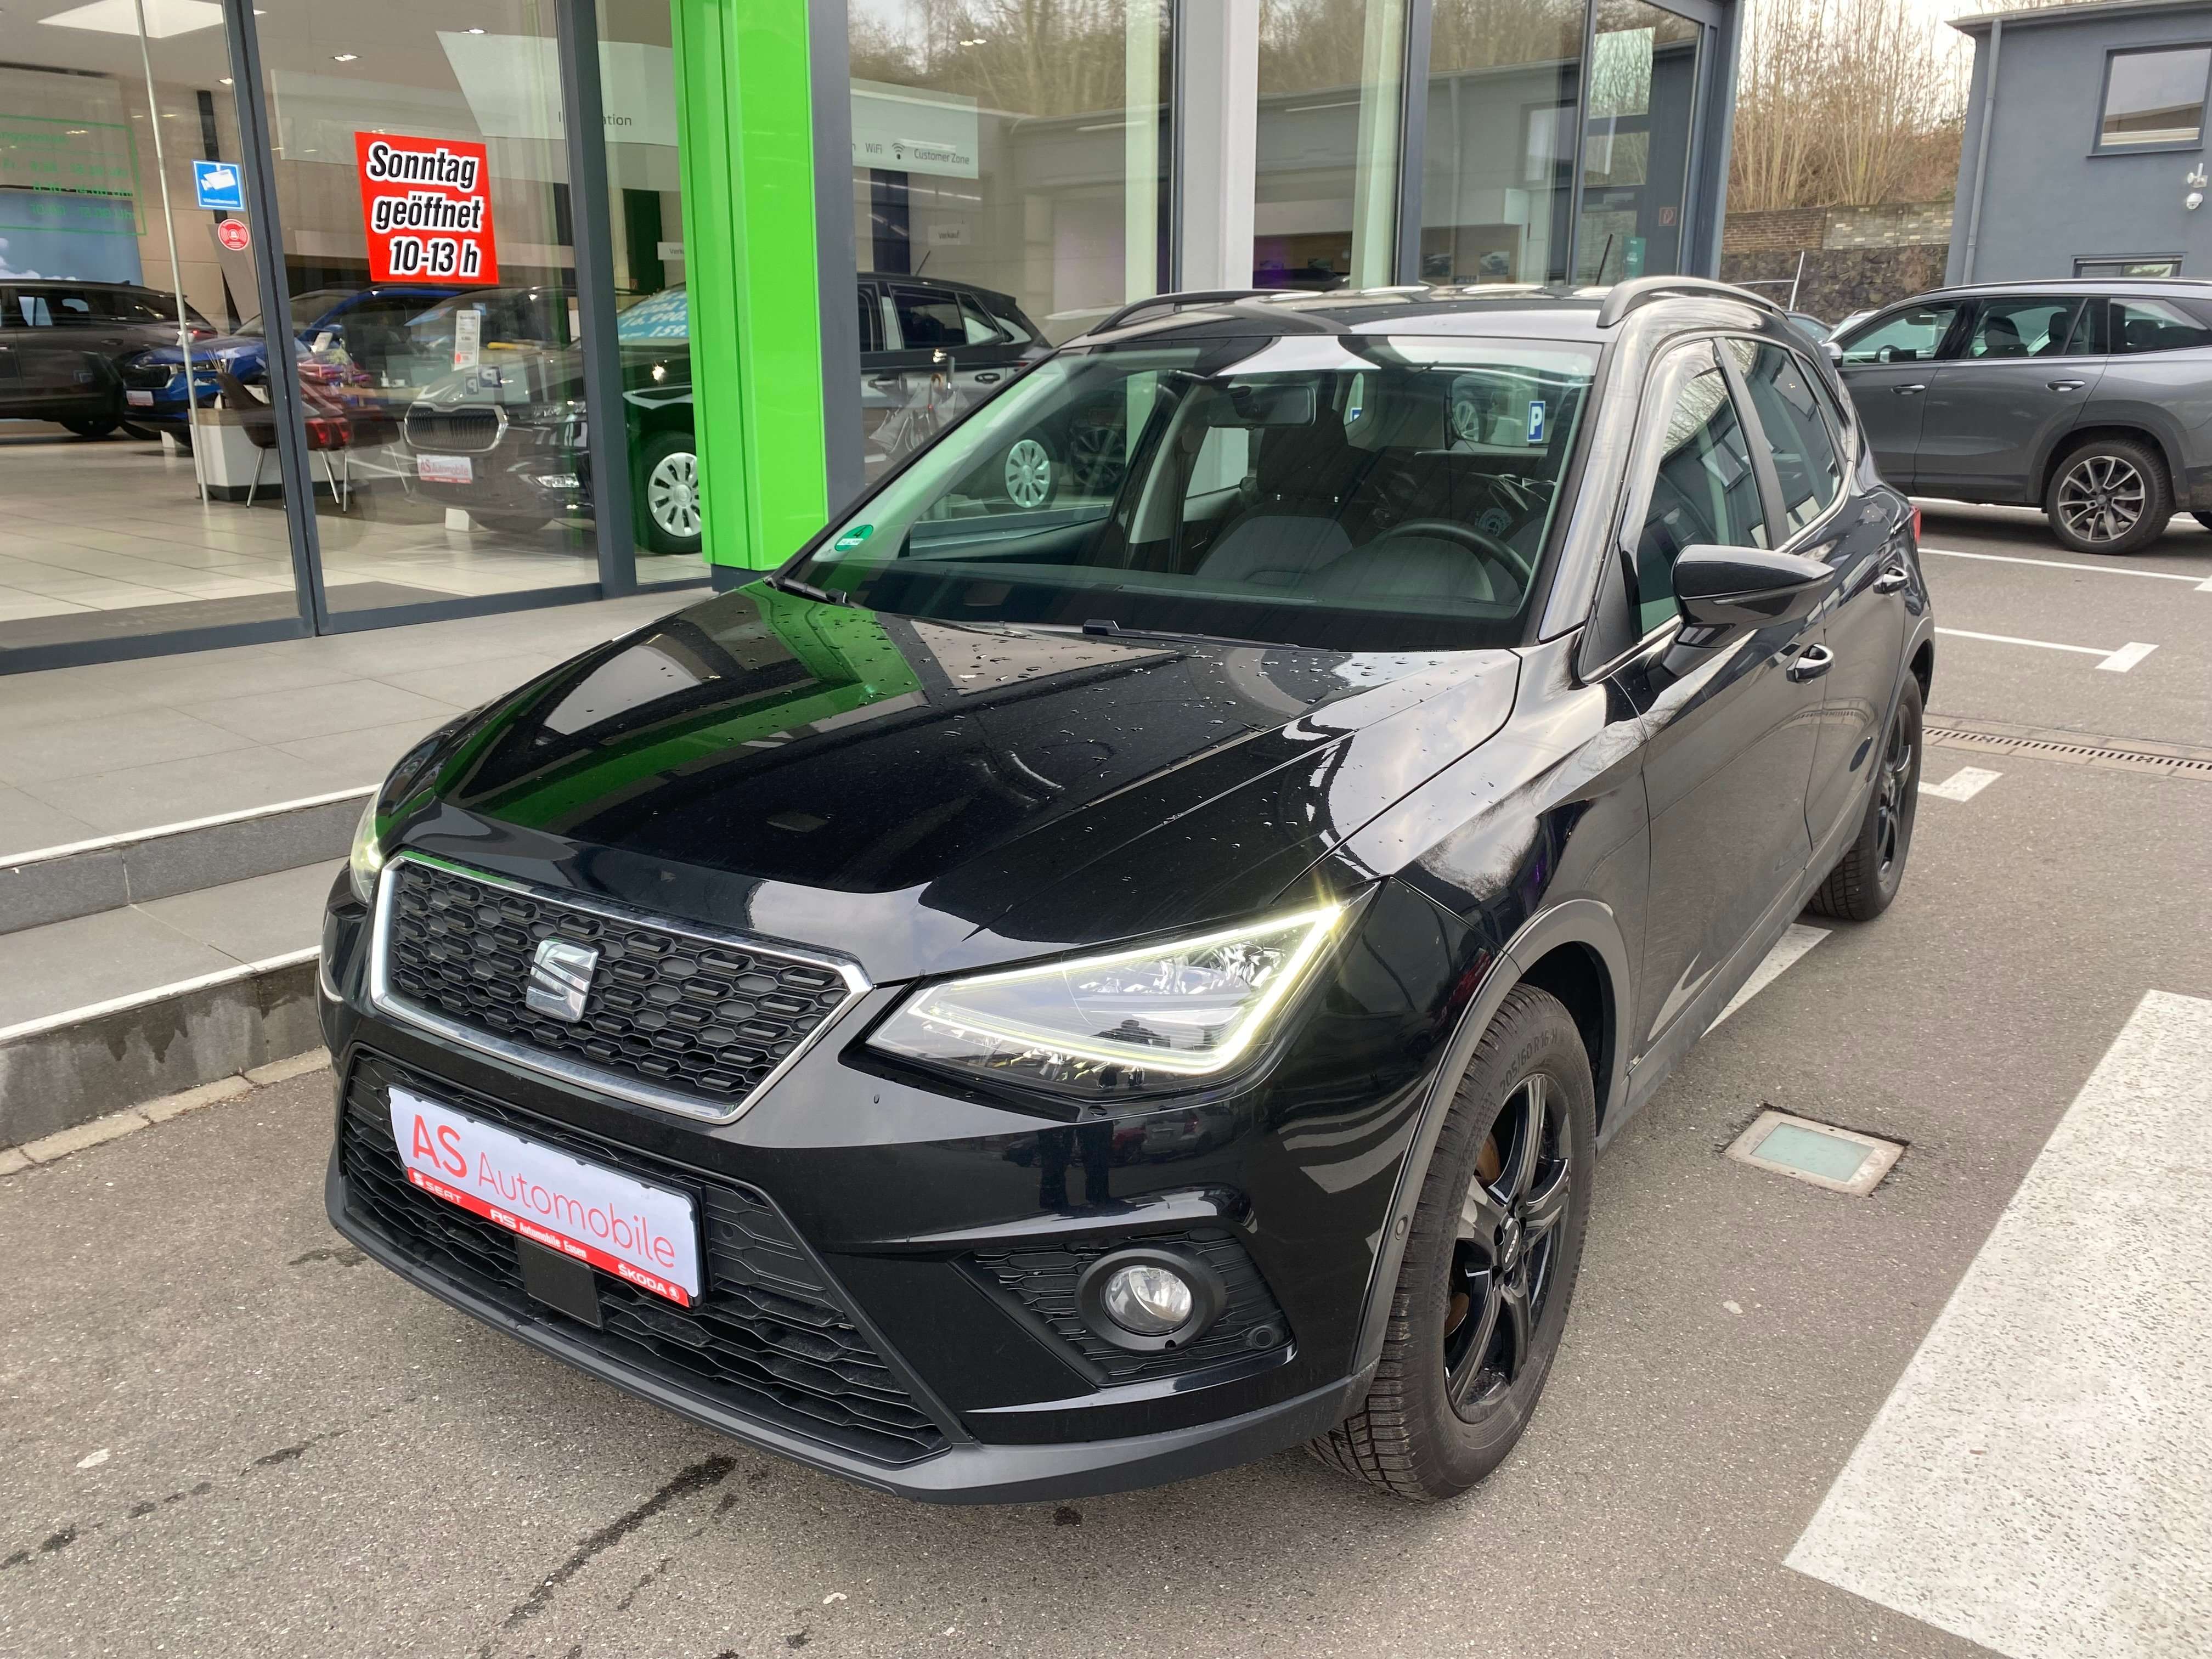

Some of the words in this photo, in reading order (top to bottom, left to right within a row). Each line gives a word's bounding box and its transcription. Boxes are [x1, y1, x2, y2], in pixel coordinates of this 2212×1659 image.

[370, 144, 476, 189] Sonntag
[865, 143, 883, 154] WiFi
[913, 149, 950, 162] Customer
[951, 153, 970, 165] Zone
[375, 194, 481, 230] geöffnet
[938, 229, 960, 240] Verkauf
[393, 240, 455, 272] 10-13
[462, 243, 478, 273] h
[1530, 406, 1543, 436] P
[853, 526, 868, 538] 4
[413, 1114, 467, 1178] AS
[478, 1152, 675, 1268] Automobile
[425, 1181, 462, 1204] SEAT
[490, 1208, 516, 1228] AS
[520, 1221, 561, 1248] Automobile
[563, 1239, 587, 1259] Essen
[618, 1263, 668, 1295] ŠKODA
